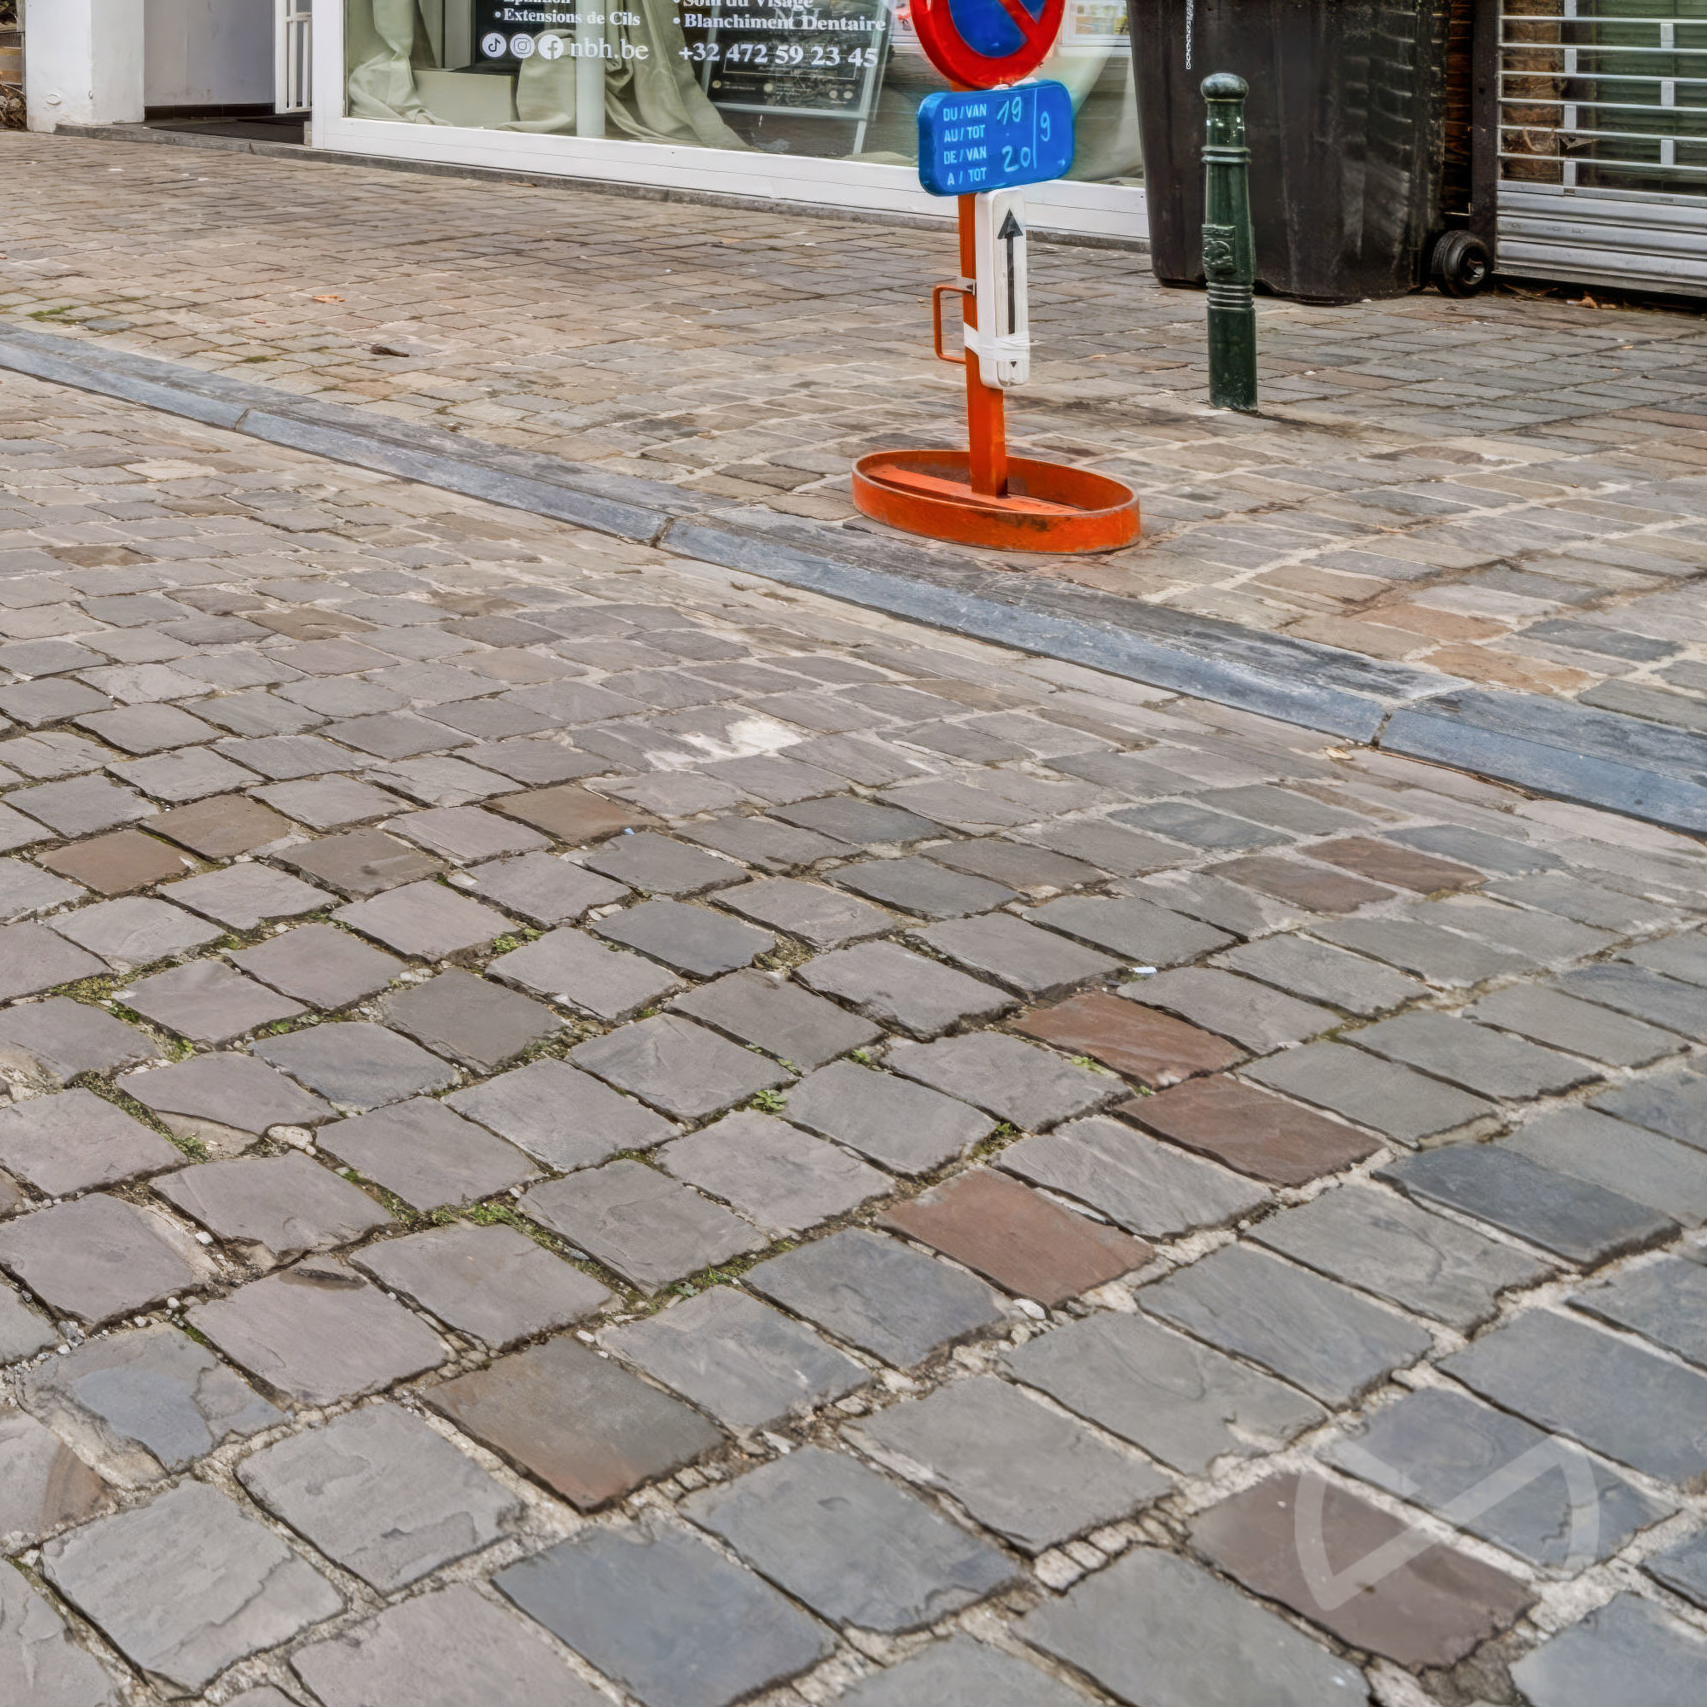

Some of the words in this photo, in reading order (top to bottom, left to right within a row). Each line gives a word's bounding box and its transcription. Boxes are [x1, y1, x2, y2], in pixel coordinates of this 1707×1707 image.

[503, 8, 582, 25] Extensions
[586, 11, 606, 25] de
[609, 11, 641, 27] Cils
[683, 13, 794, 29] Blanchiment
[802, 15, 886, 31] Dentaire
[569, 36, 649, 61] nbh.be
[678, 42, 720, 61] +32
[726, 44, 768, 63] 472
[774, 45, 804, 65] 59
[810, 46, 841, 66] 23
[847, 47, 879, 68] 45
[996, 96, 1023, 126] 19
[1039, 110, 1051, 142] 9
[1001, 145, 1032, 173] 20
